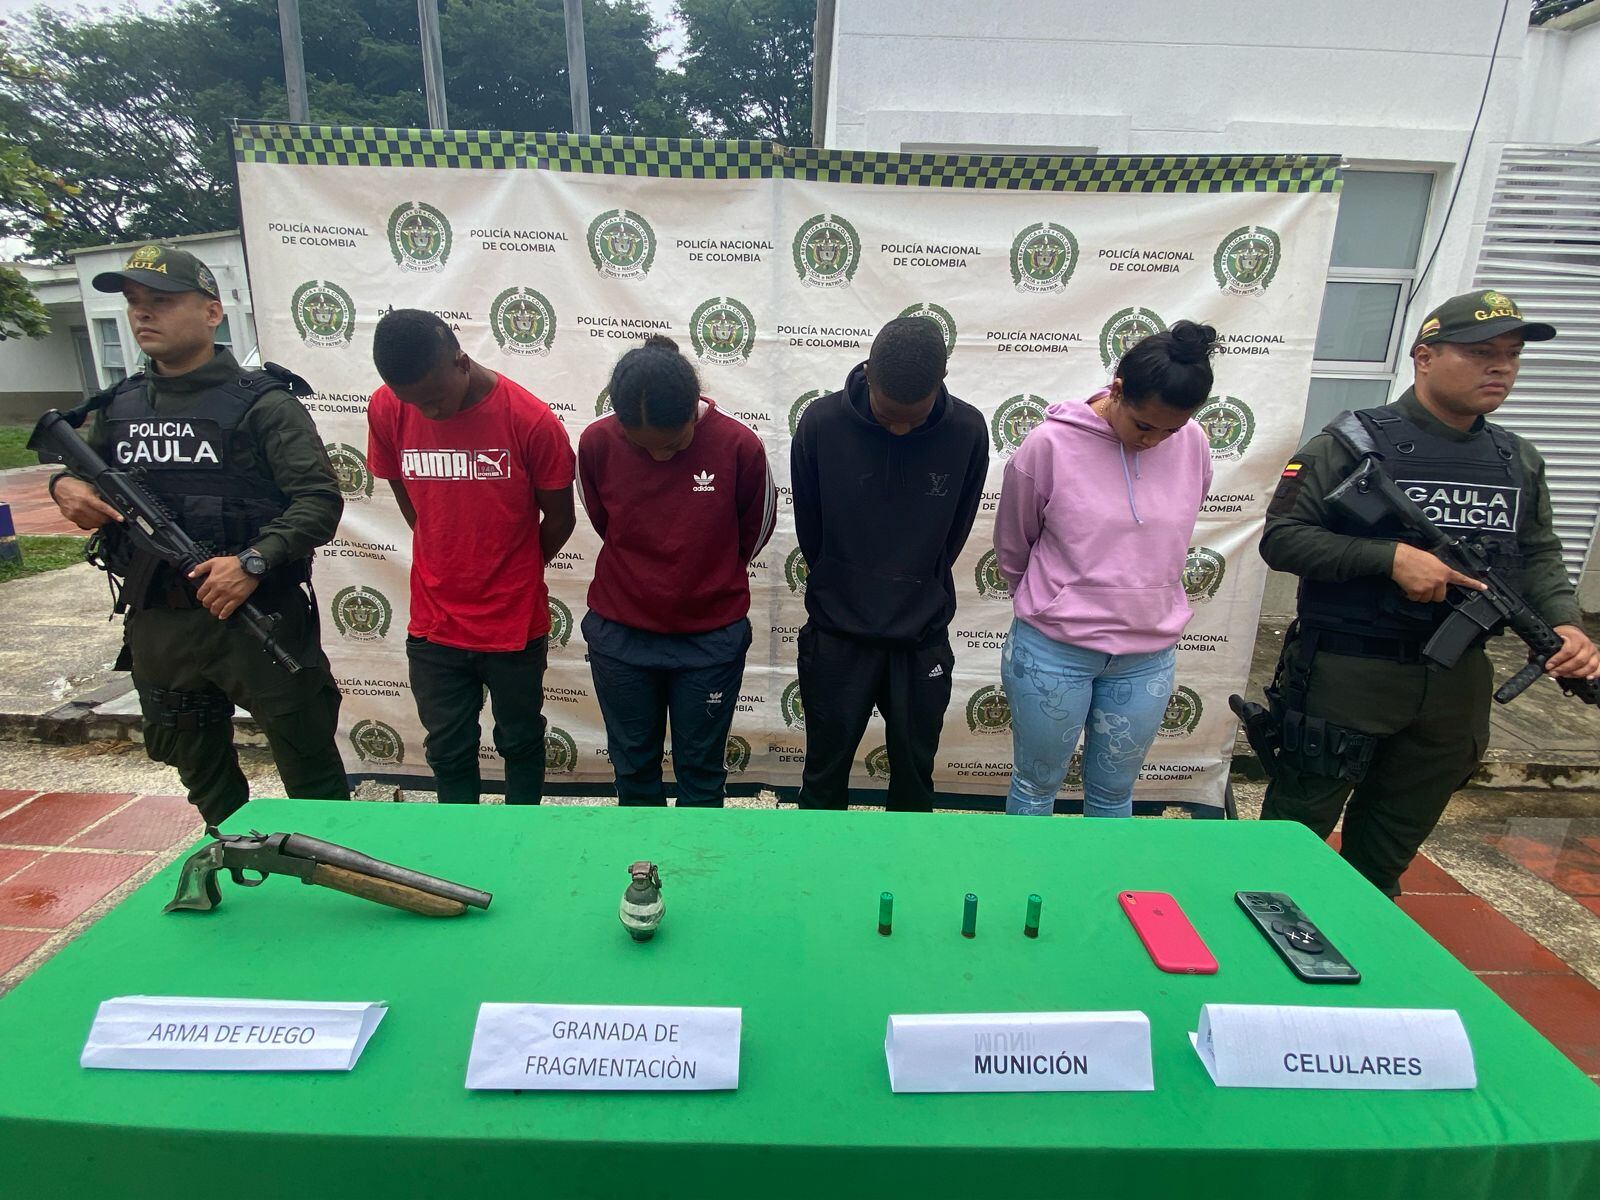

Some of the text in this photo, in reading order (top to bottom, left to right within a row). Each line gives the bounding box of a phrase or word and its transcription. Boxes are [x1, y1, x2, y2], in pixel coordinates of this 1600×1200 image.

[268, 223, 368, 236] POLICÍA NACIONAL
[470, 228, 568, 241] POLICÍA NACIONAL
[282, 236, 356, 248] DE COLOMBIA
[482, 242, 556, 253] DE COLOMBIA
[676, 238, 774, 250] POLICÍA NACIONAL
[881, 243, 981, 255] POLICÍA NACIONAL
[1098, 248, 1194, 261] POLICÍA NACIONAL
[689, 253, 761, 262] DE COLOMBIA
[893, 258, 967, 268] DE COLOMBIA
[1110, 262, 1180, 273] DE COLOMBIA
[1474, 308, 1522, 321] GAUL
[578, 316, 672, 329] POLICÍA NACIONAL
[590, 328, 655, 339] DE COLOMBI
[777, 324, 873, 337] POLICÍA NACIONAL
[986, 329, 1082, 342] POLICÍA NACIONAL
[790, 338, 860, 348] DE COLOMBIA
[1228, 335, 1285, 344] NACIONAL
[998, 344, 1068, 353] DE COLOMBIA
[300, 392, 327, 400] OLICÍA
[319, 404, 368, 413] COLOMBIA
[548, 403, 576, 411] ONAL
[130, 422, 195, 438] POLICIA
[116, 440, 219, 464] GAULA
[404, 452, 468, 477] PUMA
[1206, 494, 1255, 502] NACIONAL
[1404, 487, 1508, 509] GAULA
[1422, 506, 1510, 528] OLICIA
[352, 542, 398, 551] NACIONAL
[340, 550, 386, 560] COLOMBIA
[956, 630, 993, 638] POLICÍA
[364, 680, 410, 688] NACIONAL
[353, 689, 400, 697] COLOMBIA
[544, 687, 588, 696] NACIONAL
[769, 746, 803, 754] POLICÍA
[947, 761, 982, 769] POLICÍA
[148, 1024, 315, 1044] ARMA DE FUEGO
[553, 1020, 679, 1042] GRANADA DE
[526, 1055, 697, 1079] FRAGMENTACIÒN
[974, 1050, 1088, 1075] MUNICIÓN
[1284, 1052, 1422, 1076] CELULARES
